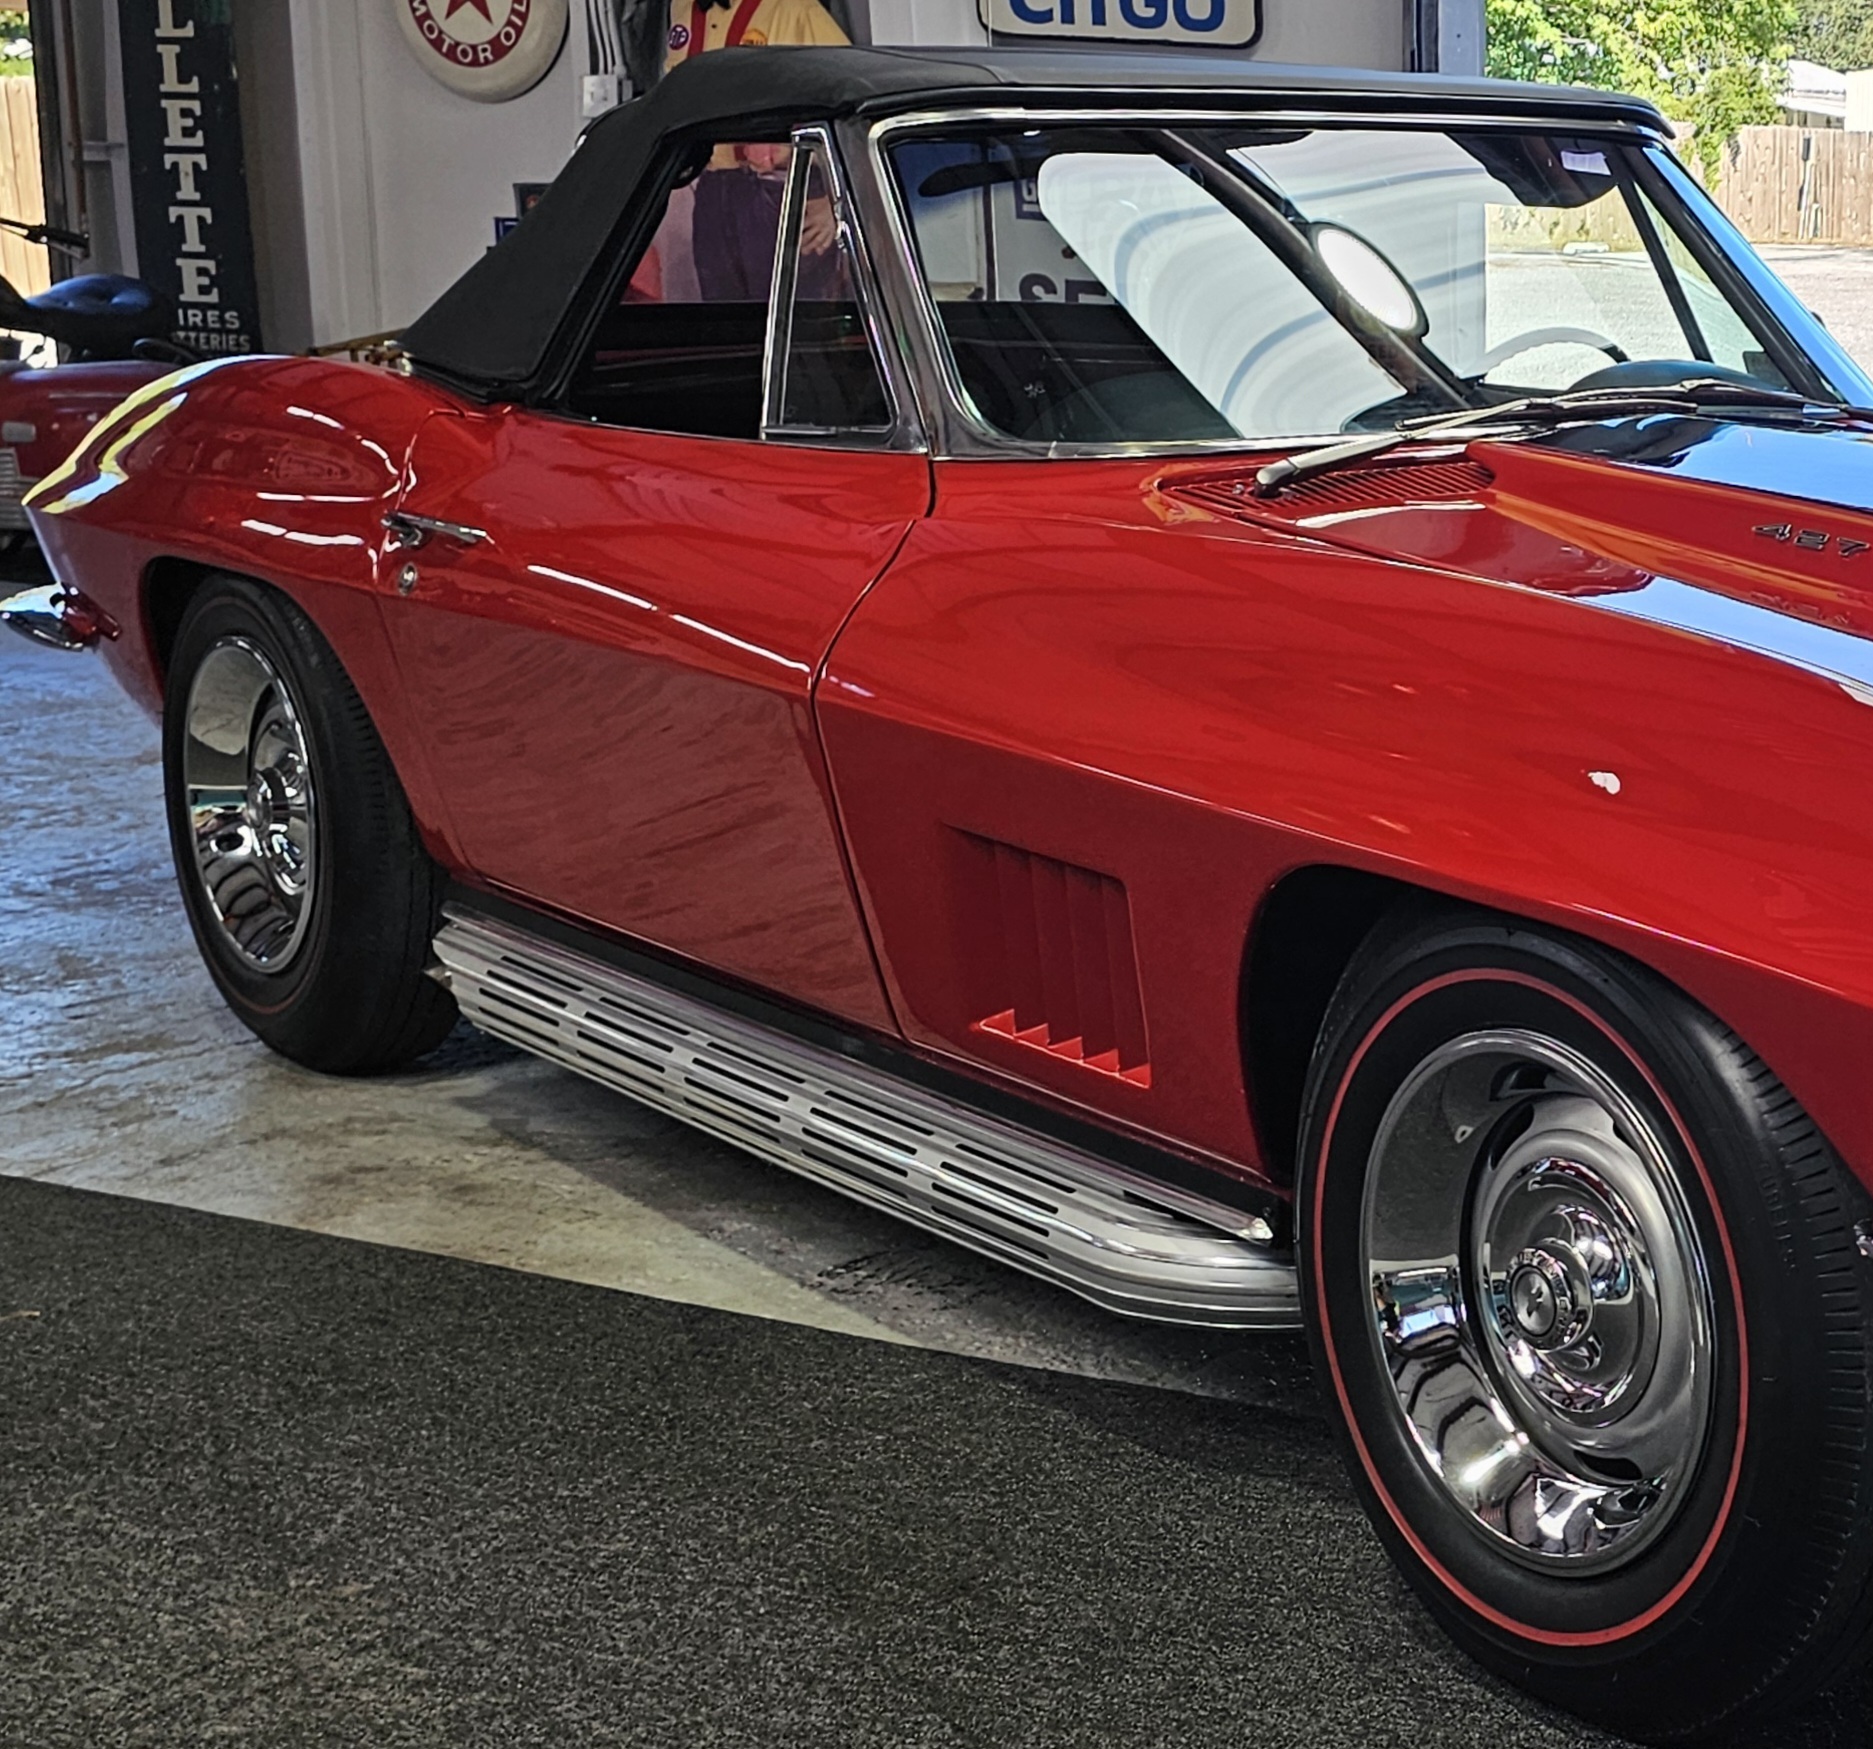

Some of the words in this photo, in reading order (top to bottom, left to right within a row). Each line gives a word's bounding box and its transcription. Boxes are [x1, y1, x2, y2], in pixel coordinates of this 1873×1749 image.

[500, 0, 527, 46] OIL
[177, 308, 241, 329] IRES
[1751, 523, 1871, 556] 427
